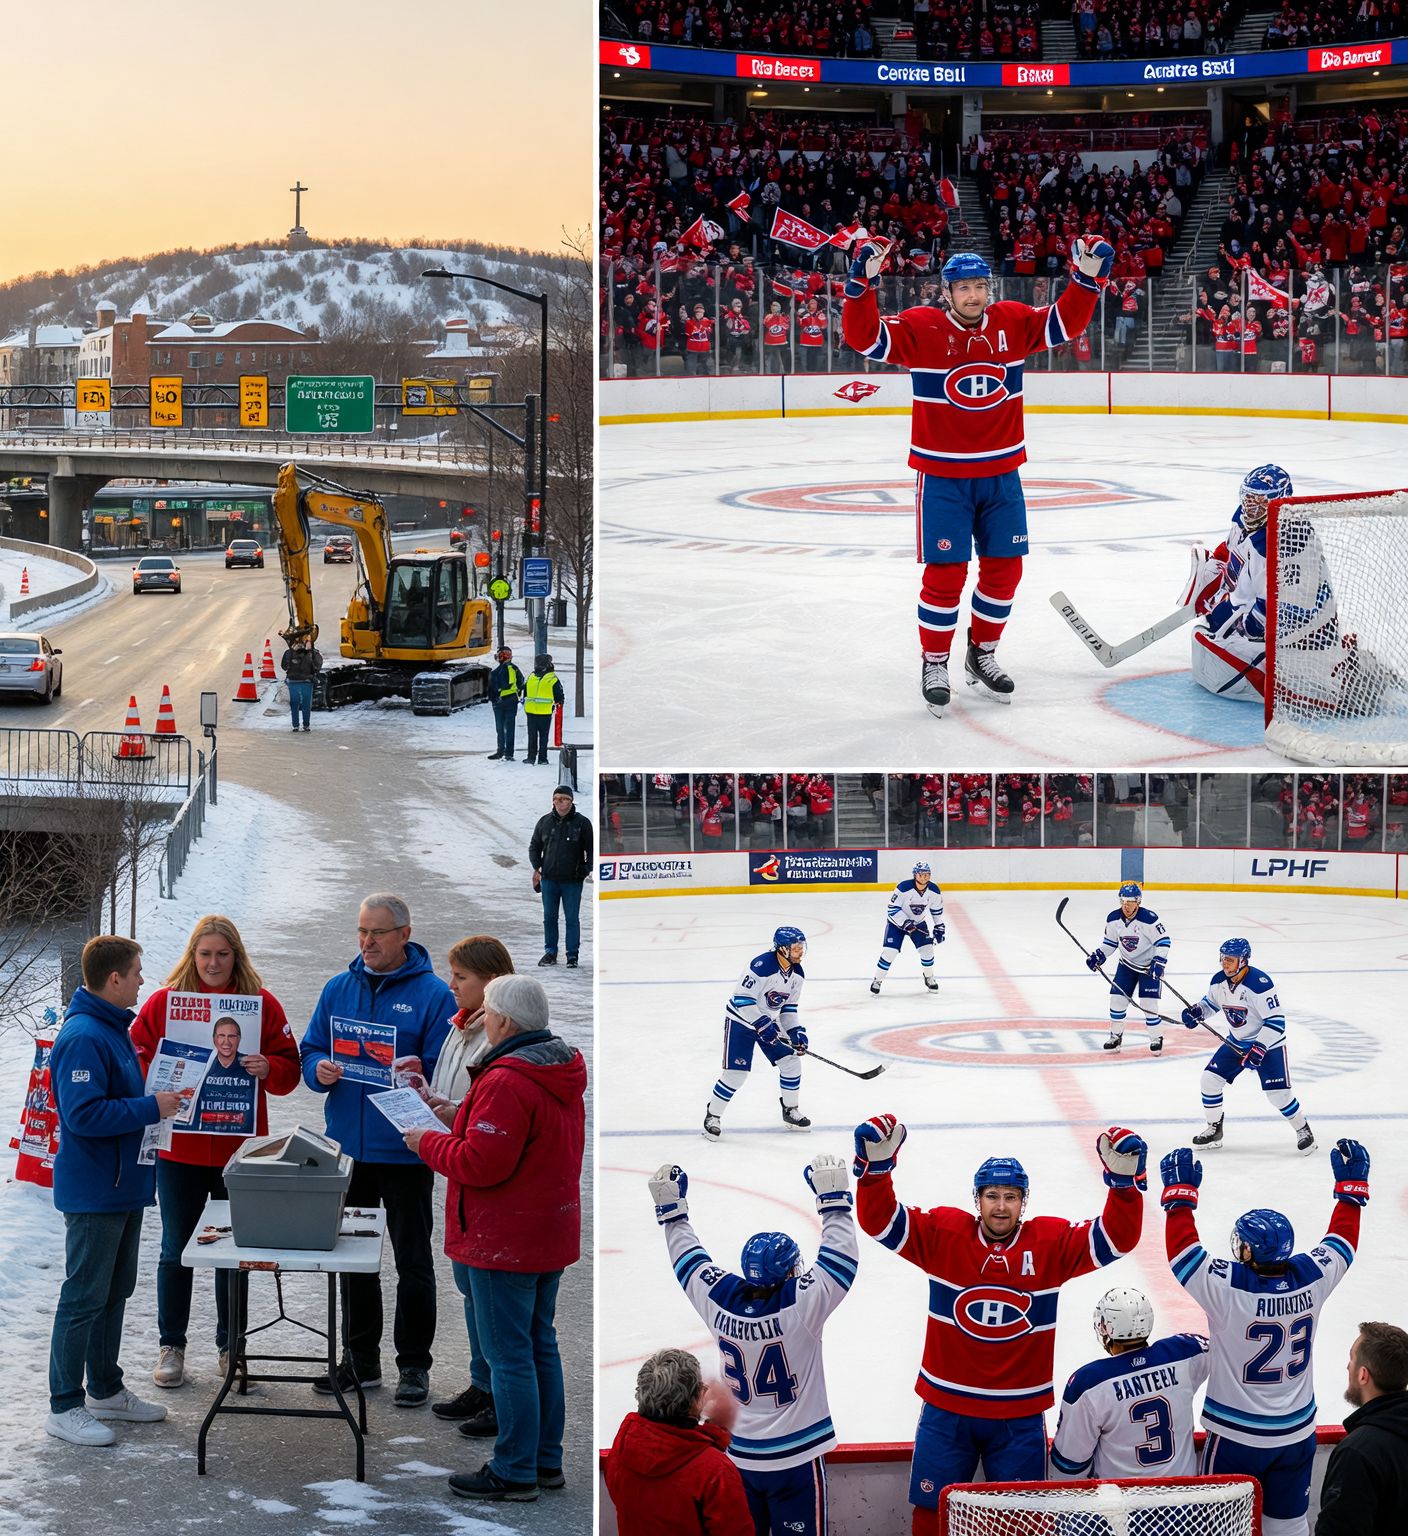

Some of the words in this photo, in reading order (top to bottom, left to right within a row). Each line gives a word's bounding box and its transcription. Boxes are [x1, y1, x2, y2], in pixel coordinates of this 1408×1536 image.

[998, 329, 1008, 352] A
[1251, 858, 1330, 878] LPHF
[1020, 1250, 1036, 1276] A
[719, 1336, 799, 1409] 34
[1243, 1313, 1314, 1385] 23
[1129, 1395, 1176, 1468] 3
